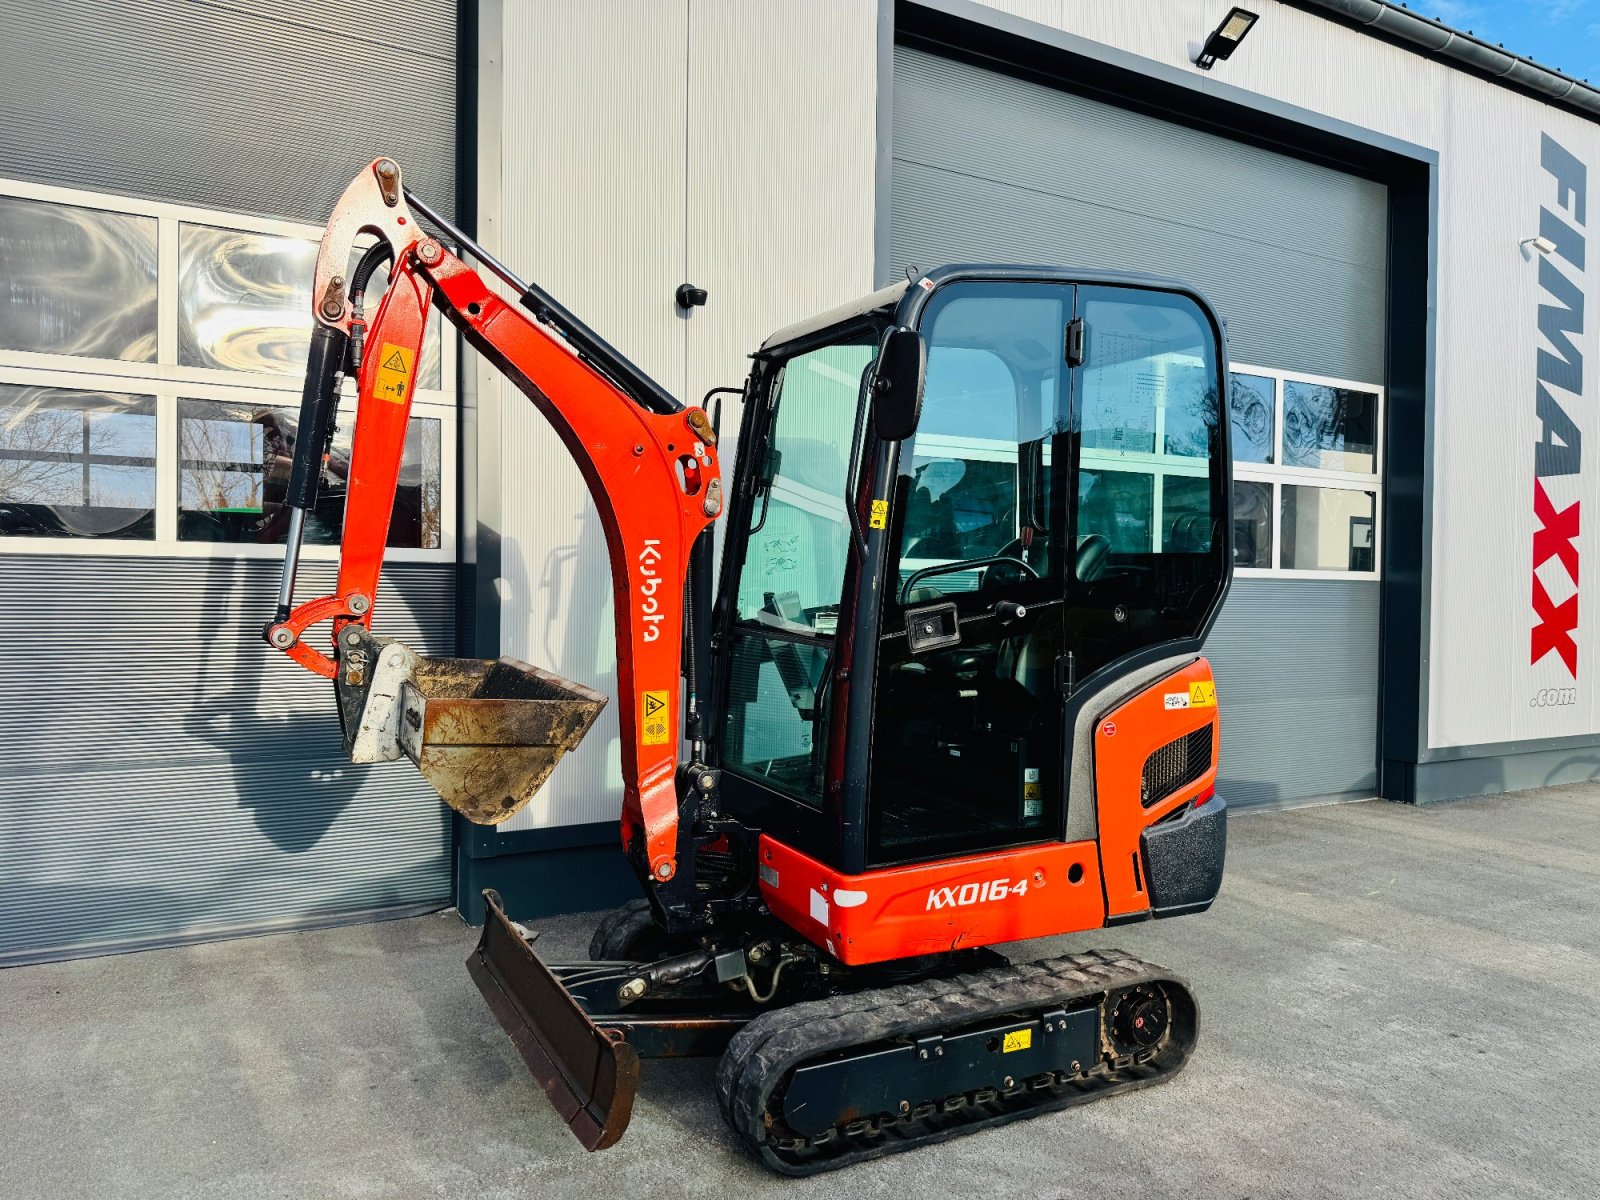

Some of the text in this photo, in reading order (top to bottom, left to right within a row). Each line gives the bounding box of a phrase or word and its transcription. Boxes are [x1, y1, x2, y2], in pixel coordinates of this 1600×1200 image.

[1531, 130, 1587, 681] FIMAXX
[639, 539, 665, 643] Kubota
[1530, 687, 1577, 708] .com
[925, 878, 1028, 911] KX016-4
